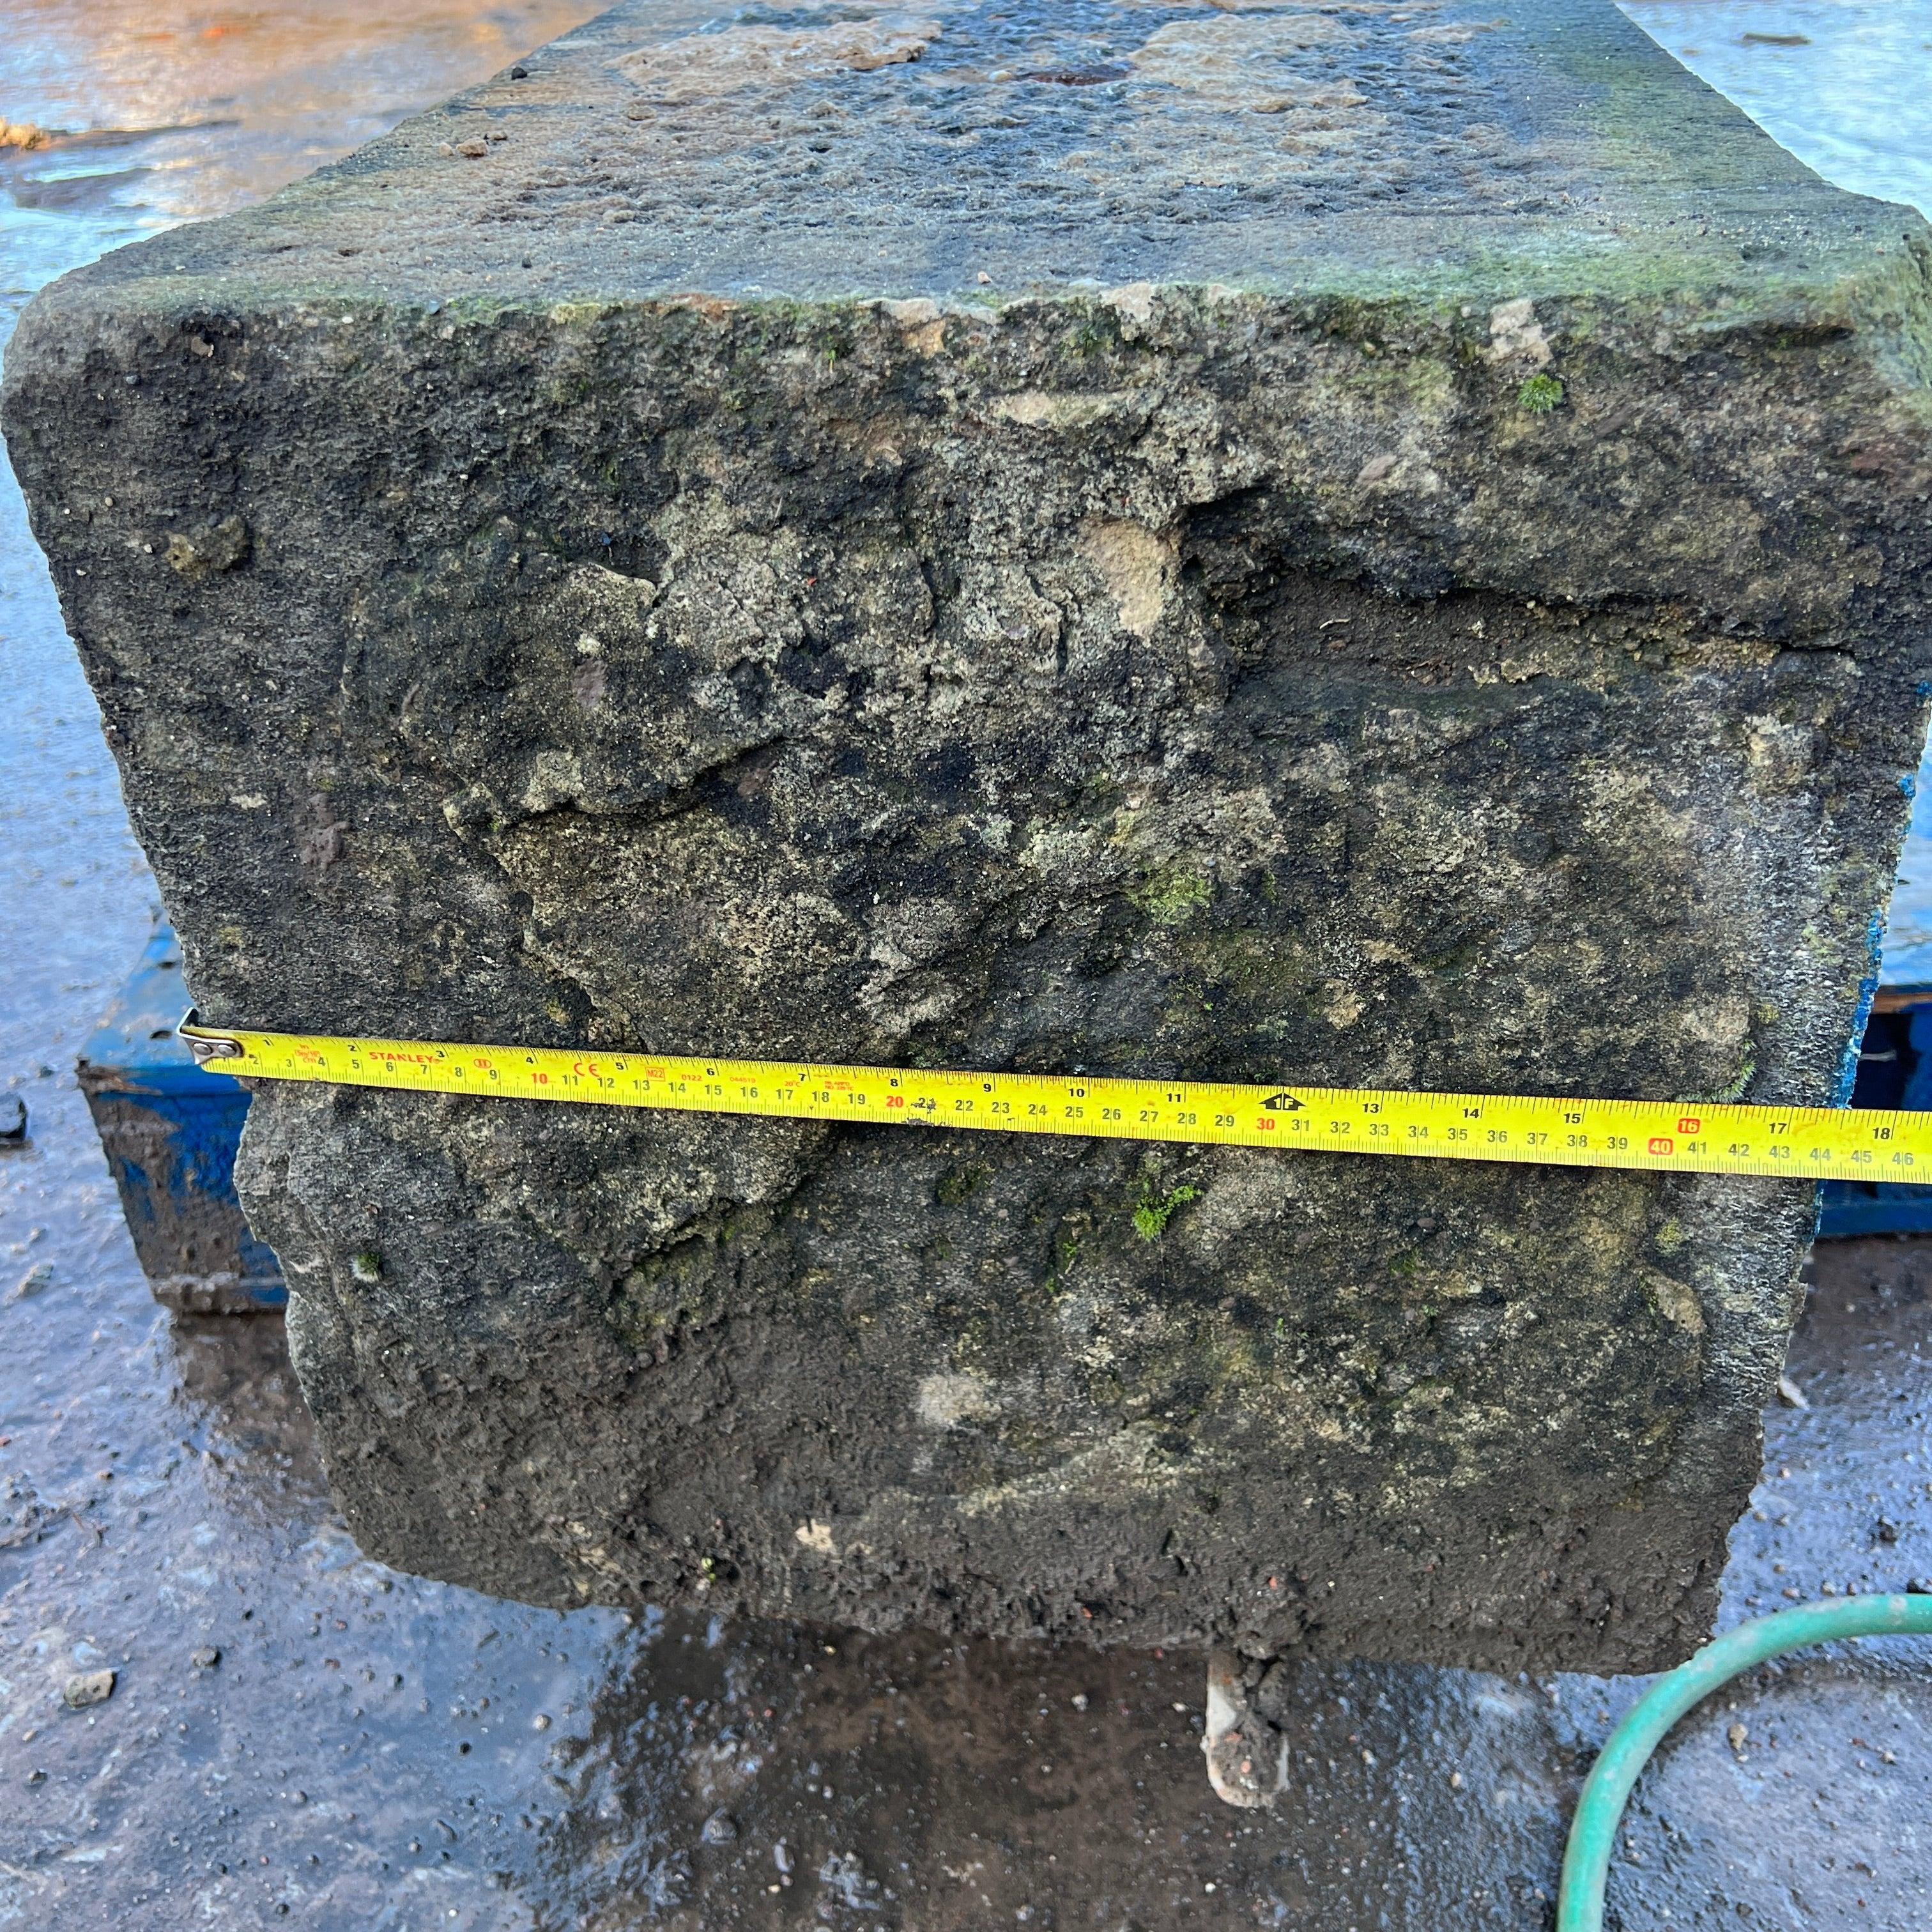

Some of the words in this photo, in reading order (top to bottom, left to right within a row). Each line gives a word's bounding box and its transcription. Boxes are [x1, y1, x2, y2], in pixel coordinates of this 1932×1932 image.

[368, 1052, 433, 1063] STANLEY
[647, 1069, 664, 1078] M22
[286, 1059, 292, 1067] 3
[318, 1057, 326, 1066] 4
[352, 1059, 360, 1069] 5
[385, 1062, 394, 1072] 6
[420, 1064, 428, 1074] 7
[455, 1067, 463, 1077] 8
[489, 1070, 497, 1080] 9
[531, 1073, 548, 1084] 10
[562, 1075, 578, 1085] 11
[597, 1077, 615, 1088] 12
[632, 1080, 650, 1091] 13
[668, 1082, 687, 1093] 14
[705, 1084, 722, 1096] 15
[740, 1087, 758, 1098] 16
[776, 1089, 793, 1100] 17
[812, 1091, 830, 1102] 18
[848, 1093, 866, 1105] 19
[886, 1095, 904, 1107] 20
[955, 1100, 974, 1111] 22
[992, 1101, 1009, 1114] 23
[1028, 1103, 1047, 1116] 24
[1065, 1106, 1084, 1118] 25
[1102, 1108, 1121, 1120] 26
[1139, 1110, 1158, 1123] 27
[1177, 1112, 1196, 1124] 28
[1215, 1114, 1234, 1127] 29
[1257, 1117, 1275, 1130] 30
[1291, 1119, 1310, 1131] 31
[1330, 1121, 1351, 1133] 32
[1369, 1123, 1389, 1136] 33
[1408, 1126, 1429, 1138] 34
[1447, 1128, 1468, 1140] 35
[1487, 1130, 1507, 1143] 36
[1527, 1132, 1548, 1145] 37
[1567, 1135, 1588, 1147] 38
[1607, 1137, 1628, 1149] 39
[1650, 1140, 1671, 1154] 40
[1687, 1141, 1706, 1154] 41
[1728, 1144, 1750, 1156] 42
[1769, 1146, 1790, 1158] 43
[1809, 1148, 1831, 1161] 44
[1850, 1150, 1872, 1163] 45
[1892, 1153, 1914, 1165] 46
[615, 1062, 624, 1070] 5
[706, 1068, 716, 1076] 6
[797, 1073, 806, 1082] 7
[890, 1078, 899, 1087] 8
[983, 1084, 992, 1092] 9
[1068, 1088, 1085, 1098] 10
[1166, 1093, 1181, 1103] 11
[1273, 1097, 1294, 1109] 1F
[1361, 1103, 1379, 1114] 13
[1462, 1108, 1480, 1119] 14
[1563, 1113, 1581, 1124] 15
[1680, 1119, 1698, 1132] 16
[1769, 1123, 1788, 1135] 17
[1873, 1127, 1890, 1140] 18
